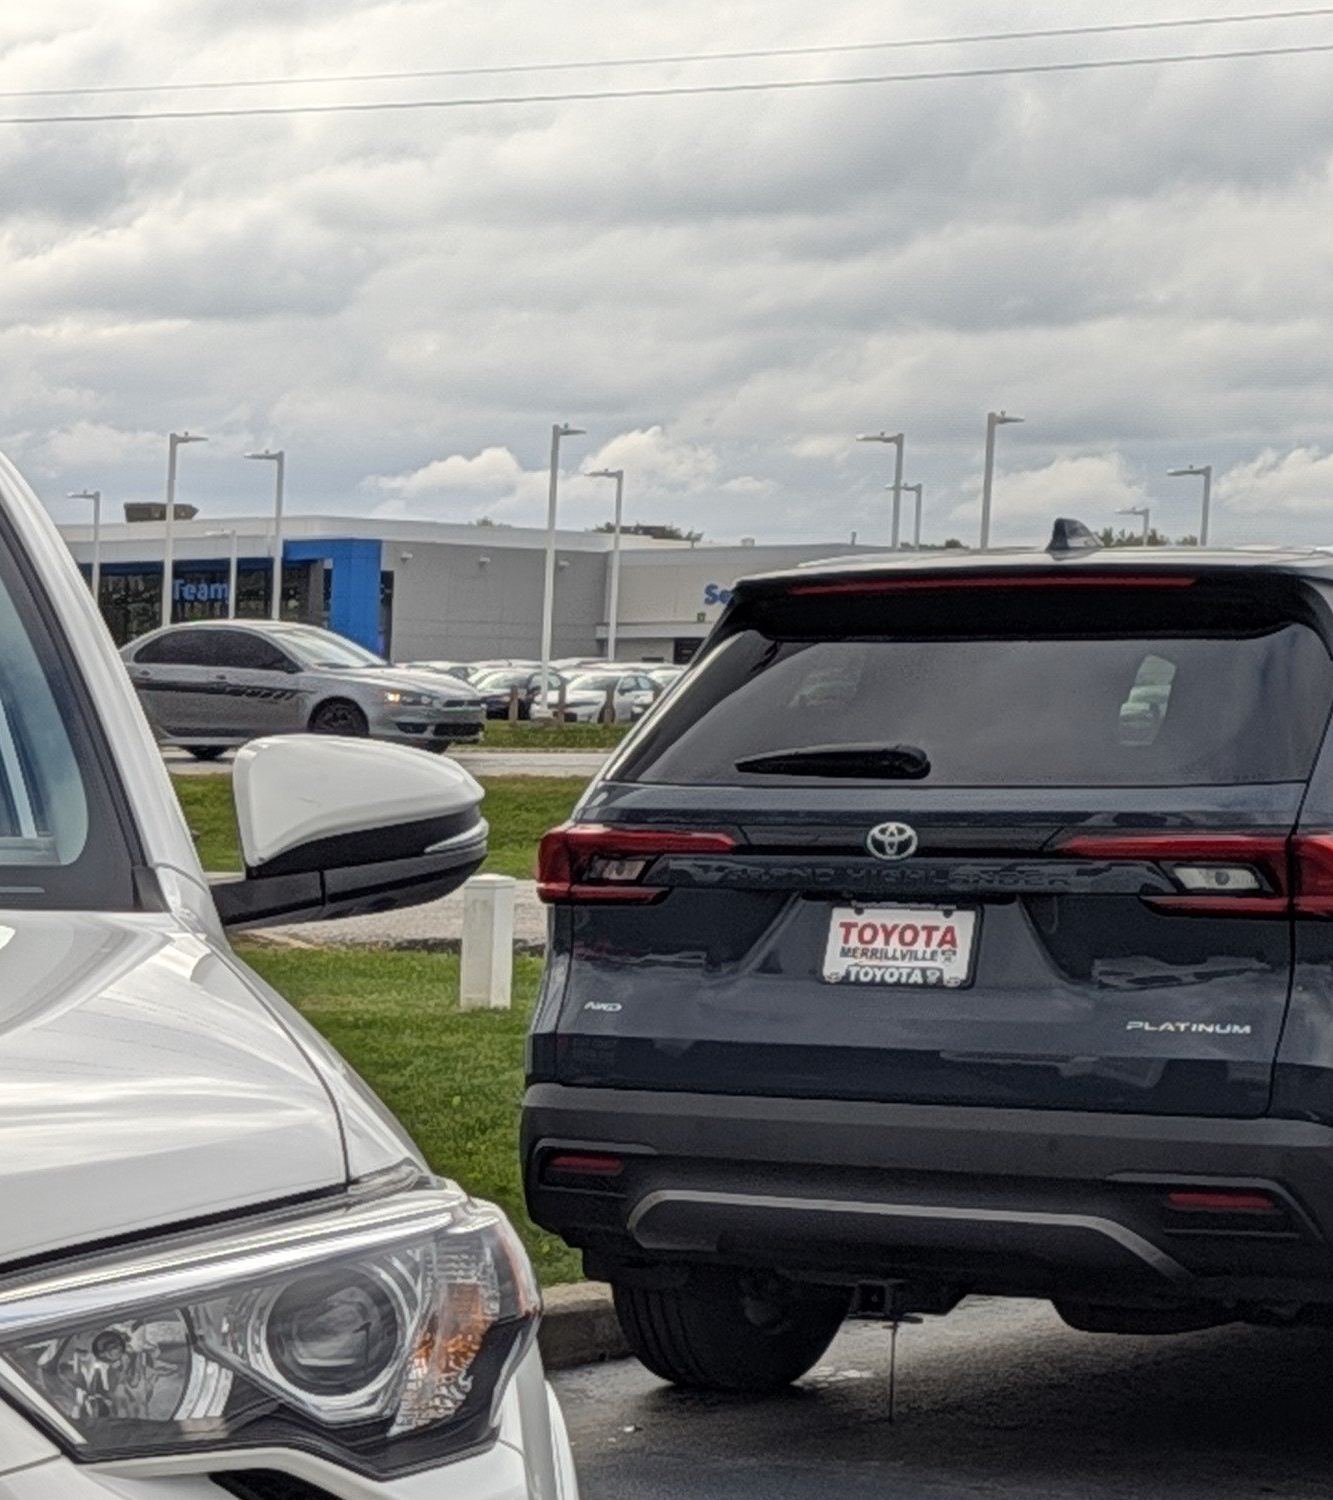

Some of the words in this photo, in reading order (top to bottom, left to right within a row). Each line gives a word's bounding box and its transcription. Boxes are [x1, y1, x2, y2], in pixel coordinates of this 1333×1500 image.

[173, 579, 230, 601] Team
[839, 921, 958, 949] TOYOTA
[839, 946, 939, 962] MERRILLVILLE
[848, 965, 923, 985] TOYOTA
[584, 1001, 622, 1012] AWD
[1126, 1020, 1252, 1035] PLATINUM
